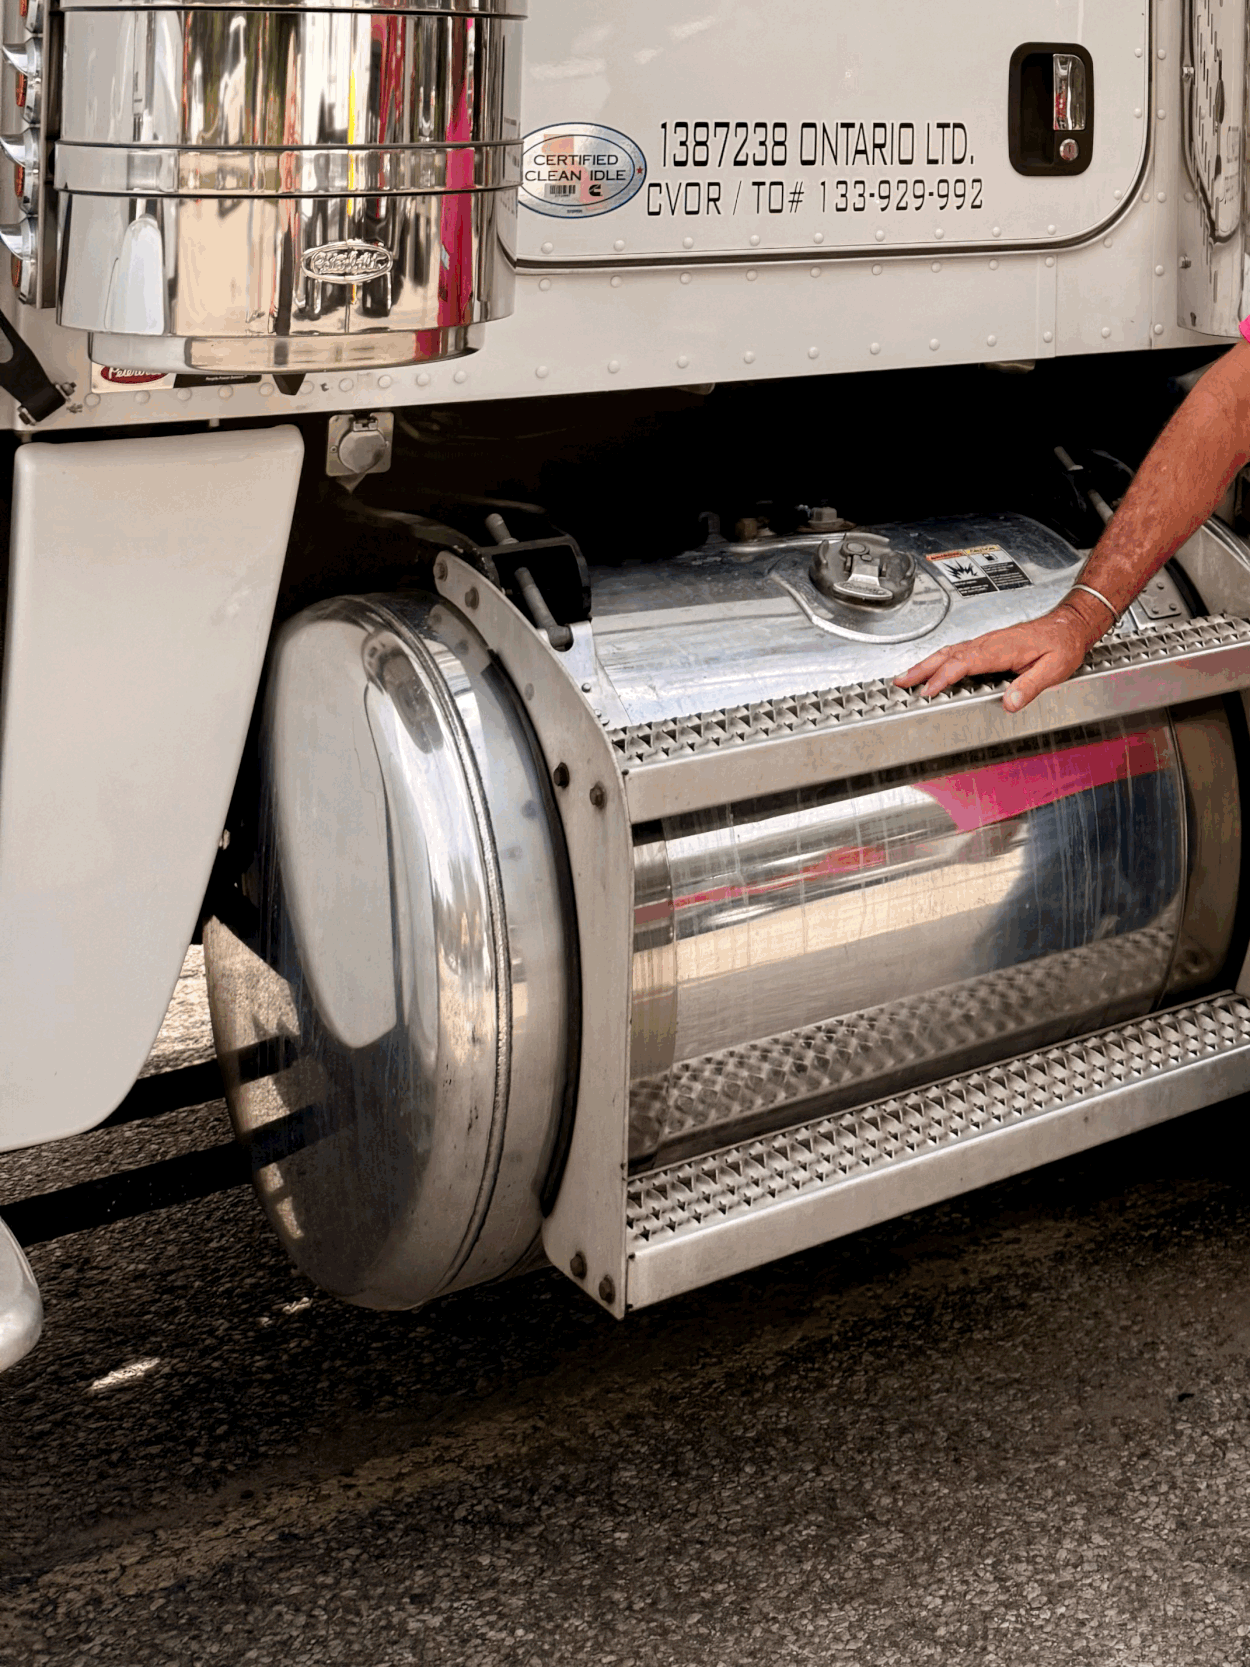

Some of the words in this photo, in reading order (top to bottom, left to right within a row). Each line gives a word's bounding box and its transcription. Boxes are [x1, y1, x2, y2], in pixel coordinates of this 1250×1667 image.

[660, 121, 788, 168] 1387238
[799, 122, 915, 166] ONTARIO
[925, 122, 975, 165] LTD.
[533, 154, 619, 166] CERTIFIED
[524, 169, 582, 182] CLEAN
[590, 169, 627, 181] IDLE
[646, 181, 722, 217] CVOR
[751, 180, 805, 214] TO#
[820, 178, 984, 213] 133-929-992
